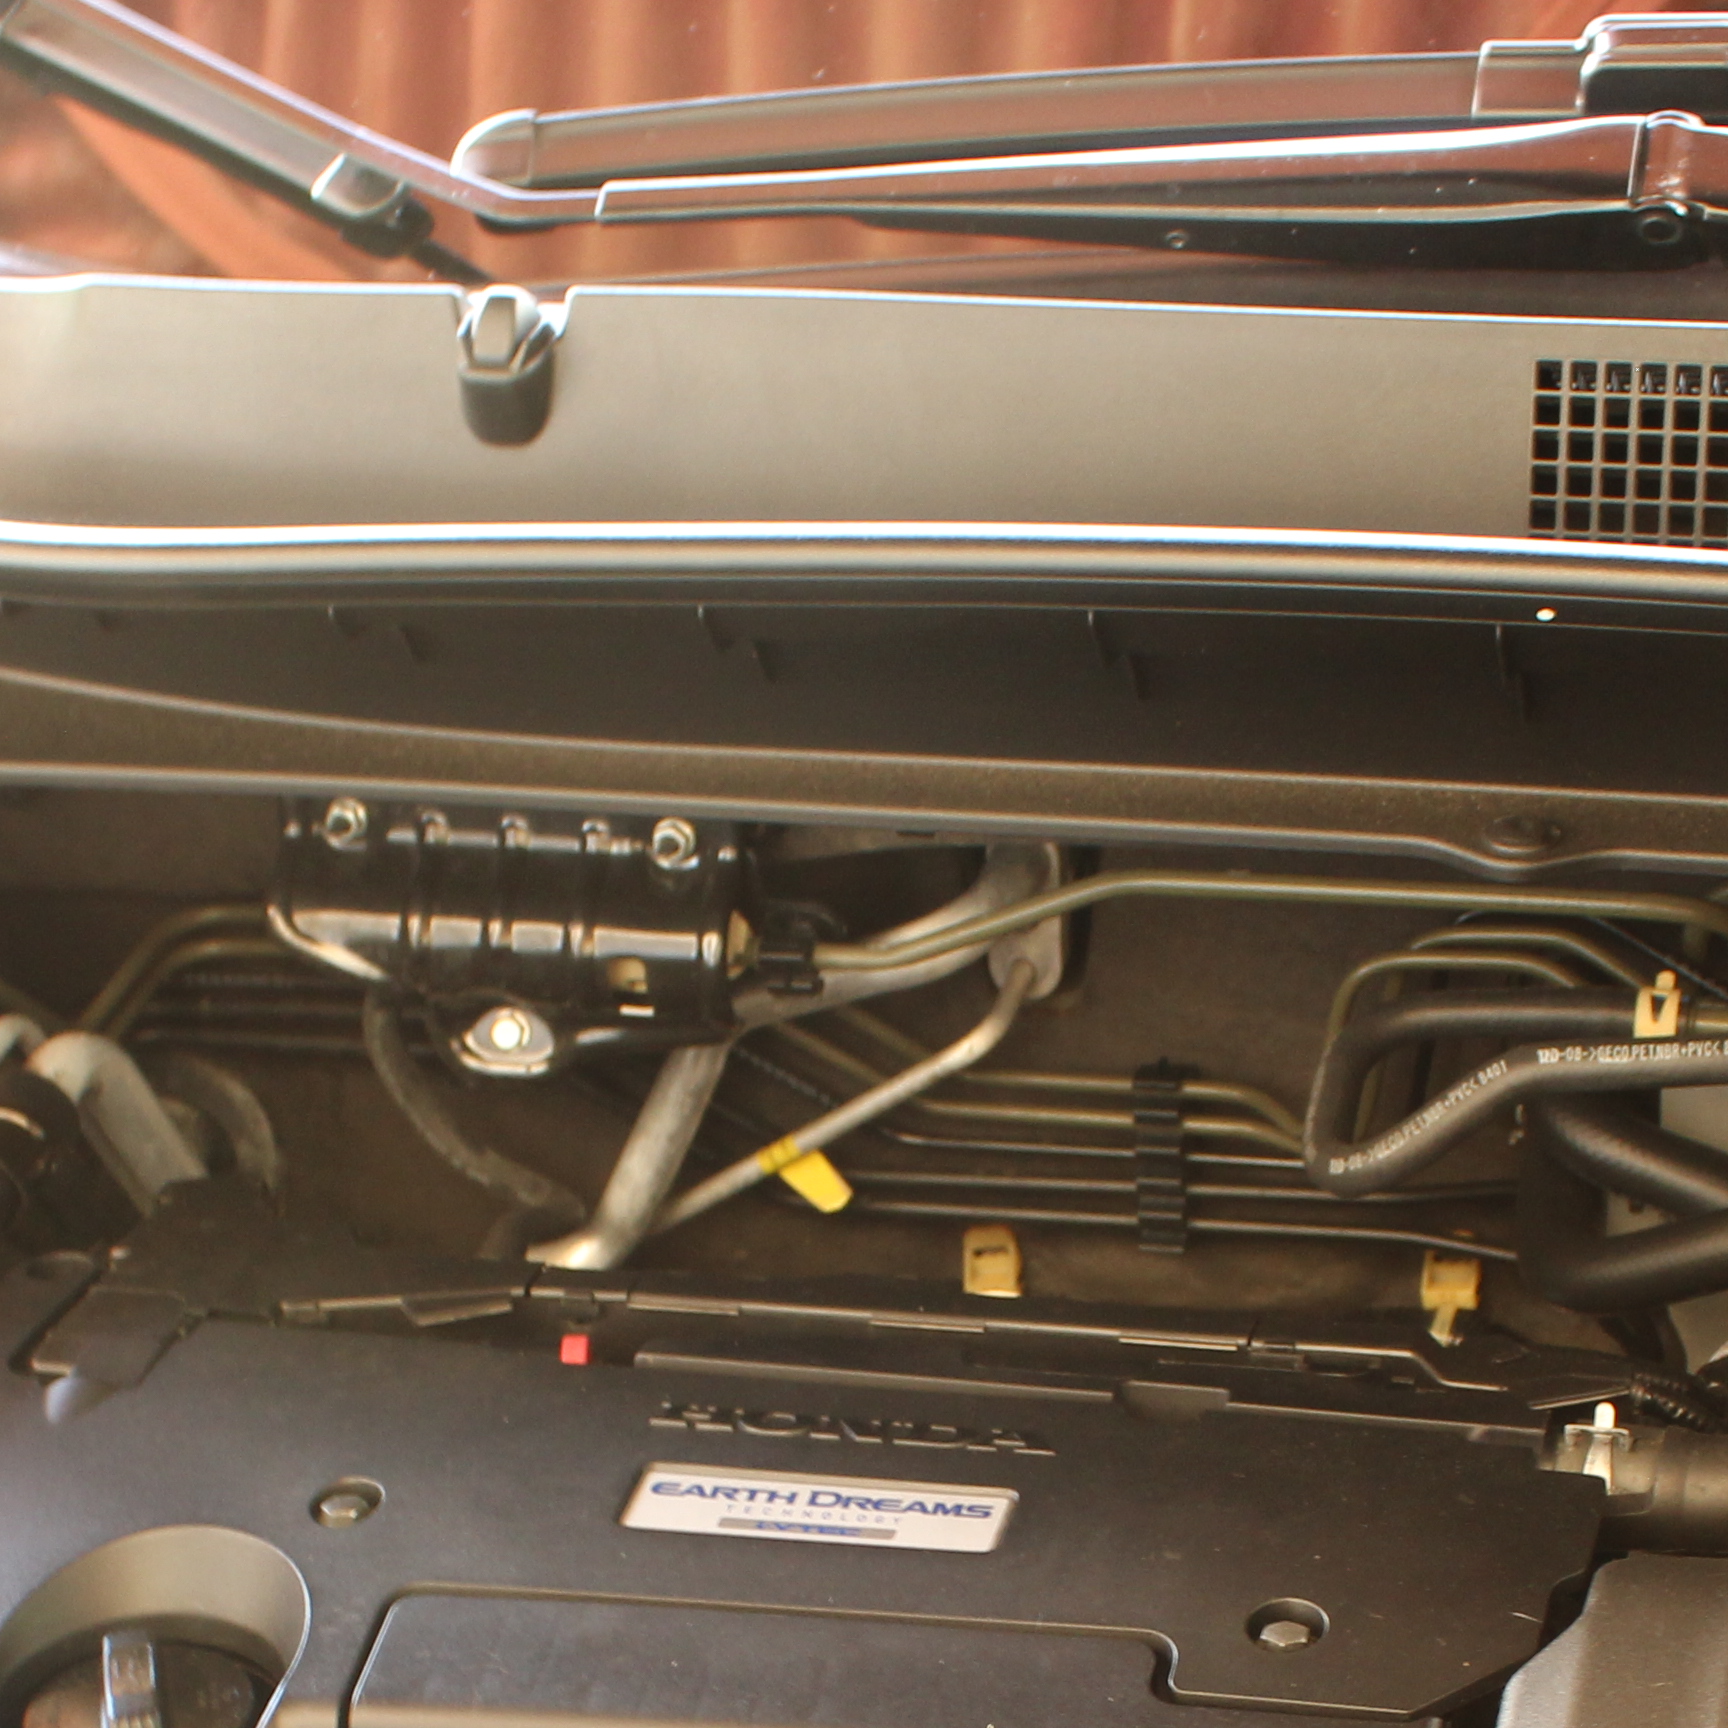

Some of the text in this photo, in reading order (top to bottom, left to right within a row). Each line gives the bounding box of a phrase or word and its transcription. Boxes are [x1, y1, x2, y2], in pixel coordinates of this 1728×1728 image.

[648, 1400, 1057, 1456] HONDA
[651, 1481, 995, 1520] EARTH DREAMS
[725, 1502, 902, 1525] TECHNOLOGY
